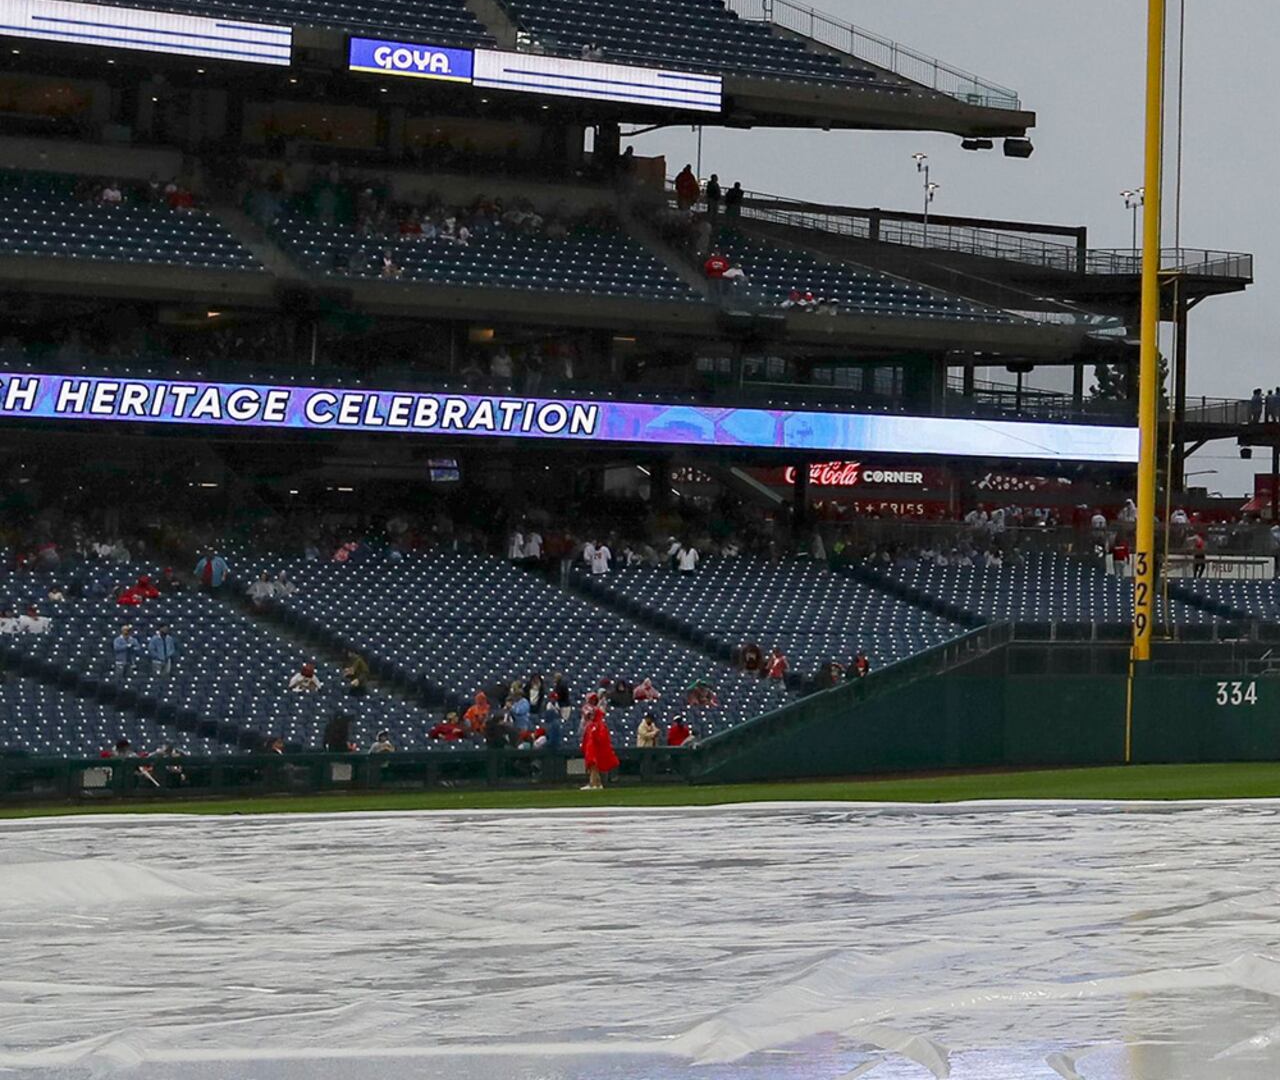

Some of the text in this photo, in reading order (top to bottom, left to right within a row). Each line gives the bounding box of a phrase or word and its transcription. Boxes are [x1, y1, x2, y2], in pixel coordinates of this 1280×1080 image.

[374, 46, 449, 73] GOYA
[55, 380, 292, 422] HERITAGE
[303, 391, 598, 436] CELEBRATION
[862, 471, 923, 485] CORNER
[1216, 681, 1258, 707] 334
